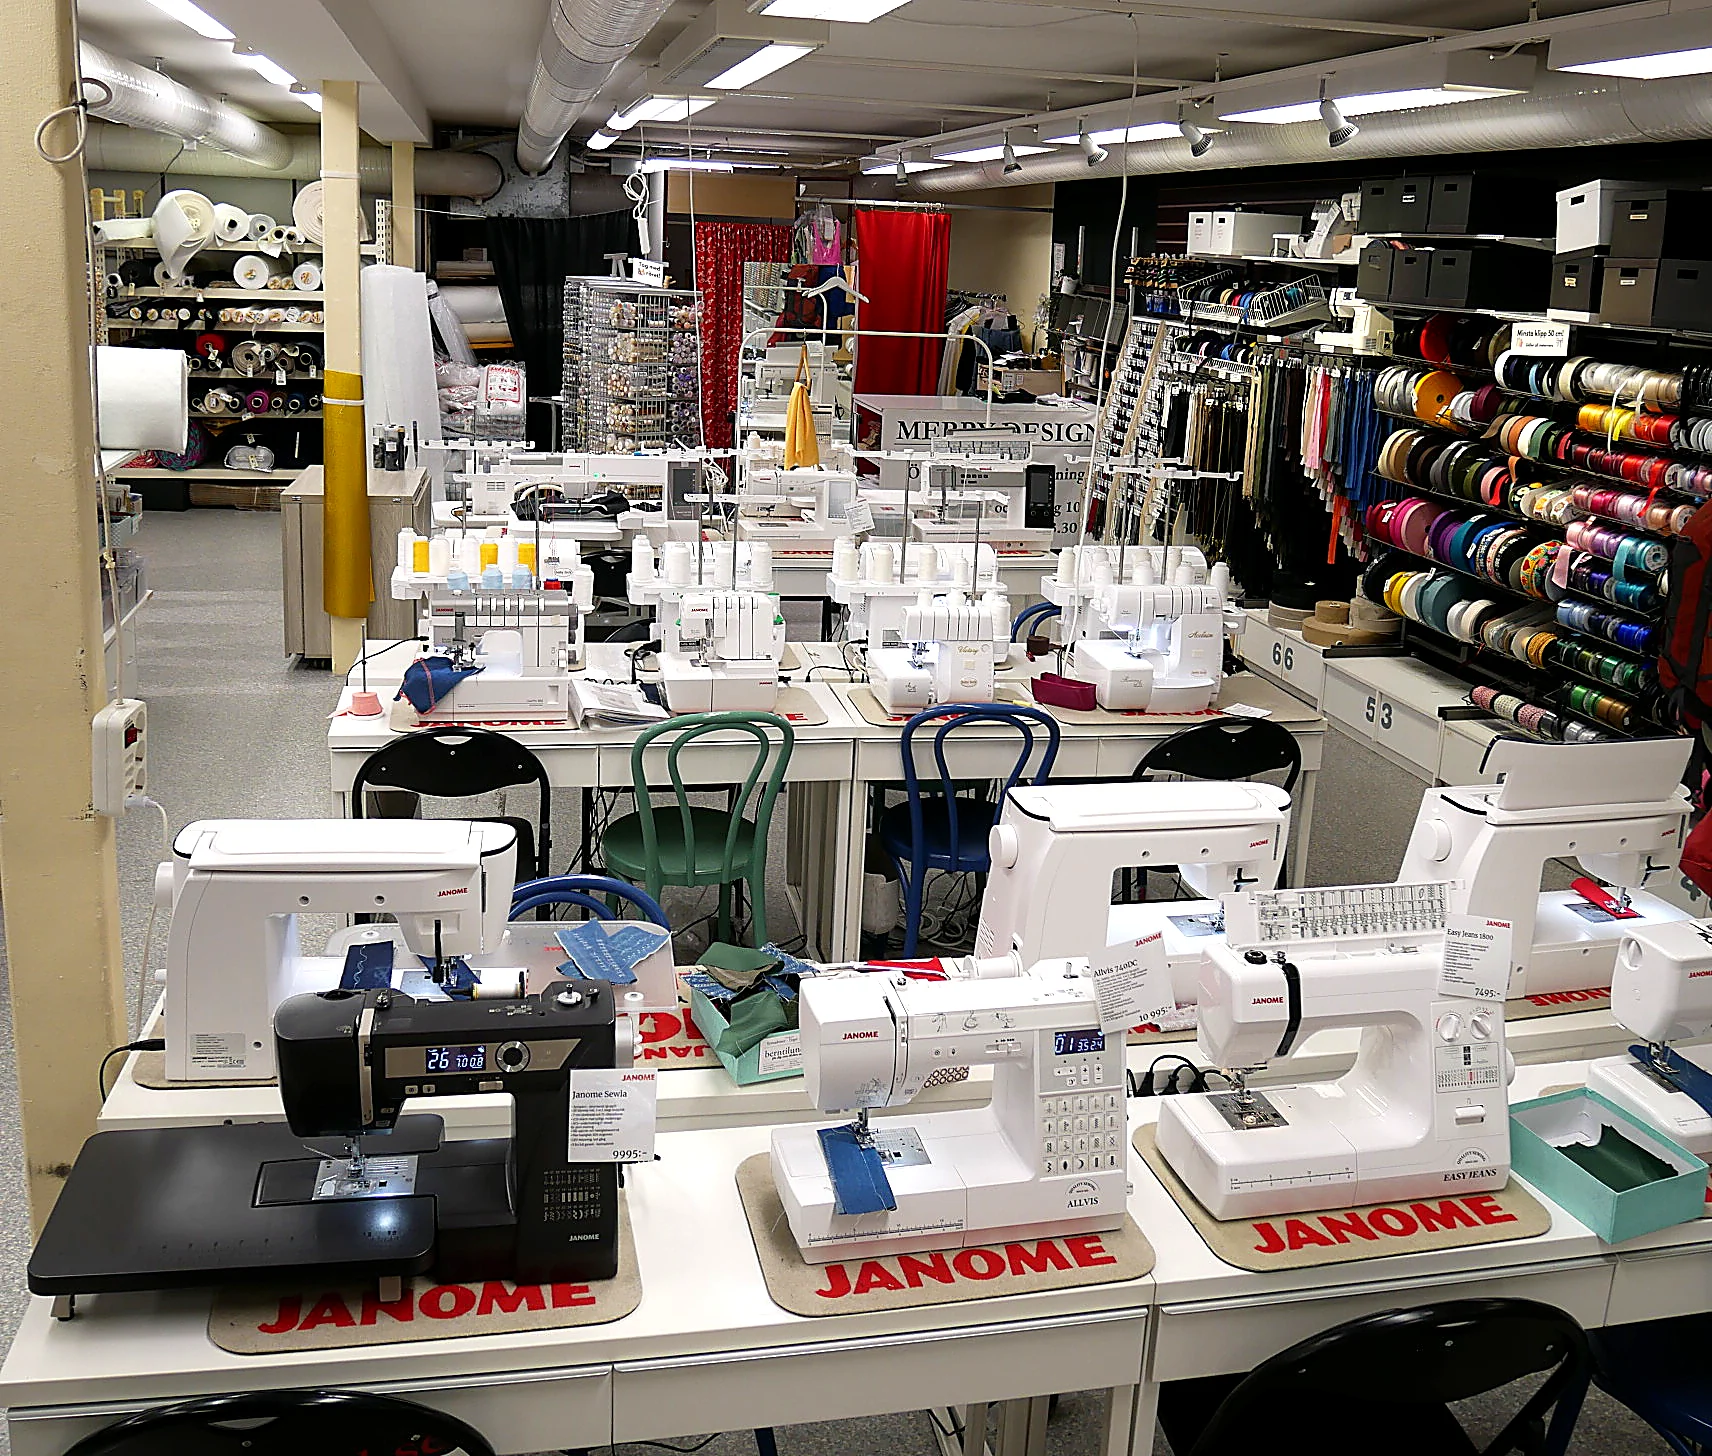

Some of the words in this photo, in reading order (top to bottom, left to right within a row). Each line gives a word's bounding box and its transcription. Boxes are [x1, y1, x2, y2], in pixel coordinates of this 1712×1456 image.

[1250, 839, 1269, 848] JANOME
[437, 887, 468, 897] JANOME
[1486, 920, 1511, 929] JANOME
[1135, 932, 1162, 947] JANOME
[1447, 929, 1461, 938] Easy
[1462, 930, 1478, 939] Jeans
[1094, 966, 1113, 977] Allvis
[1115, 960, 1138, 973] 740DC
[1475, 988, 1501, 997] 7495:-
[1252, 997, 1283, 1005] JANOME
[1150, 1006, 1172, 1019] 995:-
[843, 1031, 879, 1040] JANOME
[1055, 1037, 1074, 1053] 01
[428, 1052, 449, 1069] 26
[572, 1090, 603, 1099] Janome
[604, 1090, 627, 1098] Sewla
[612, 1149, 647, 1159] 9995:-
[1443, 1172, 1467, 1181] EASY
[1468, 1169, 1497, 1179] JEANS
[1067, 1196, 1099, 1208] ALLVIS
[1252, 1195, 1518, 1254] JANOME
[815, 1236, 1117, 1298] JANOME
[257, 1281, 596, 1334] JANOME
